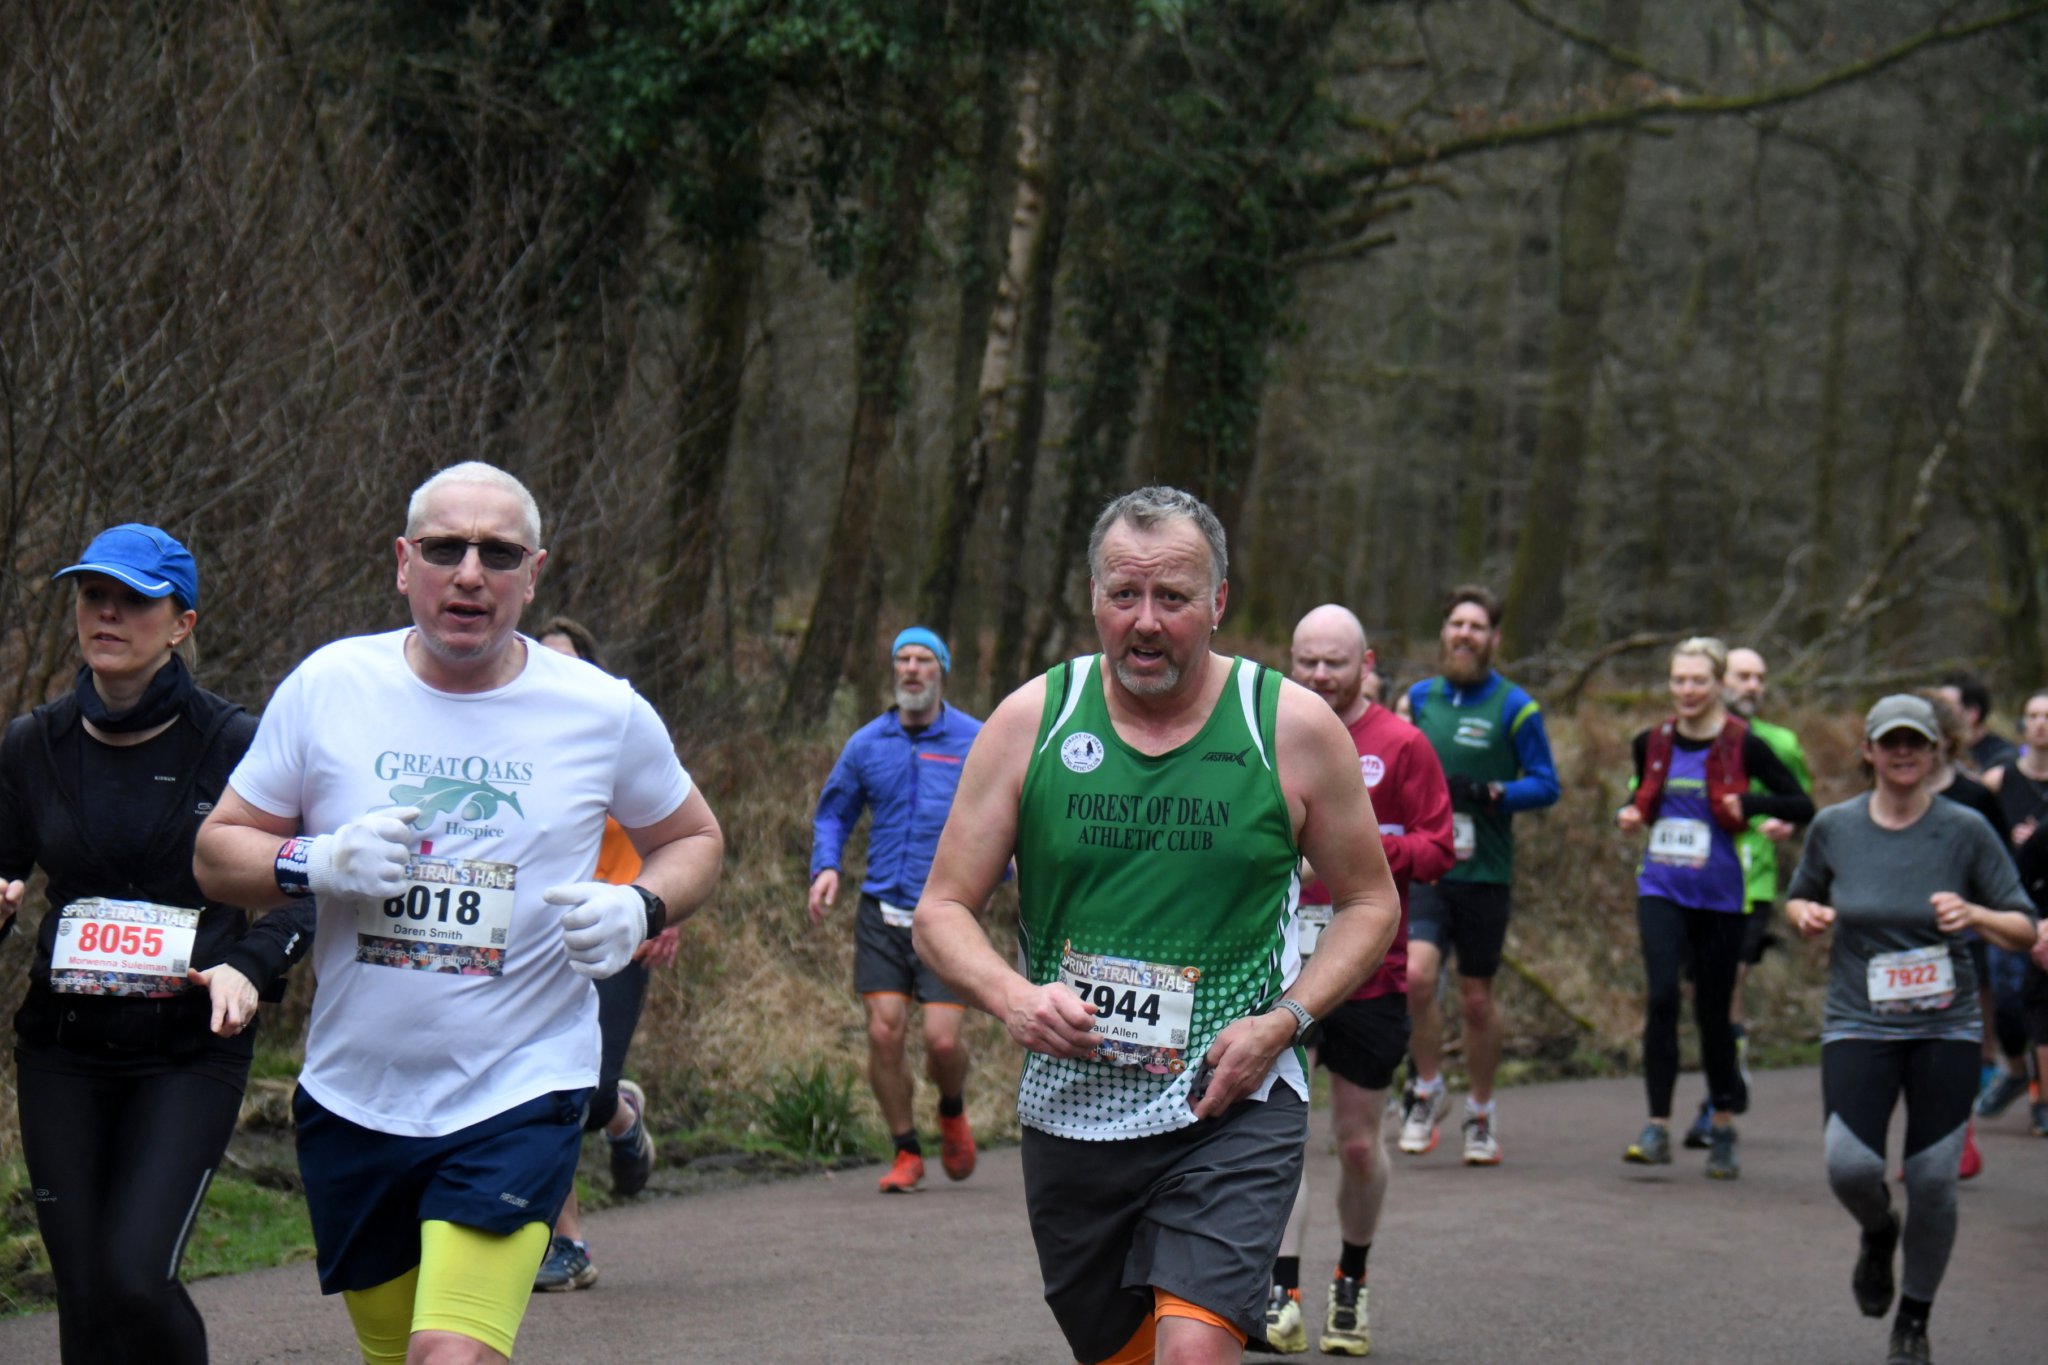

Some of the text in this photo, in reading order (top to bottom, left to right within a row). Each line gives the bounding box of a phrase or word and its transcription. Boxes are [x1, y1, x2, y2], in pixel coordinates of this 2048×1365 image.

[1066, 793, 1231, 829] FOREST OF DEAN
[445, 821, 504, 840] Hospice
[1078, 825, 1214, 852] ATHLETIC CLUB
[418, 865, 471, 884] TRAILS
[474, 869, 516, 890] HALF
[383, 884, 481, 926] 8018
[158, 911, 197, 927] HALF
[78, 922, 164, 958] 8055
[393, 924, 463, 941] Daren Smith
[68, 956, 168, 973] Morwenna Suleiman
[1886, 963, 1937, 988] 7922
[1102, 966, 1152, 987] TRAILS
[1155, 972, 1193, 993] HALF
[1074, 980, 1161, 1027] 7944
[1092, 1023, 1139, 1040] aul Allen
